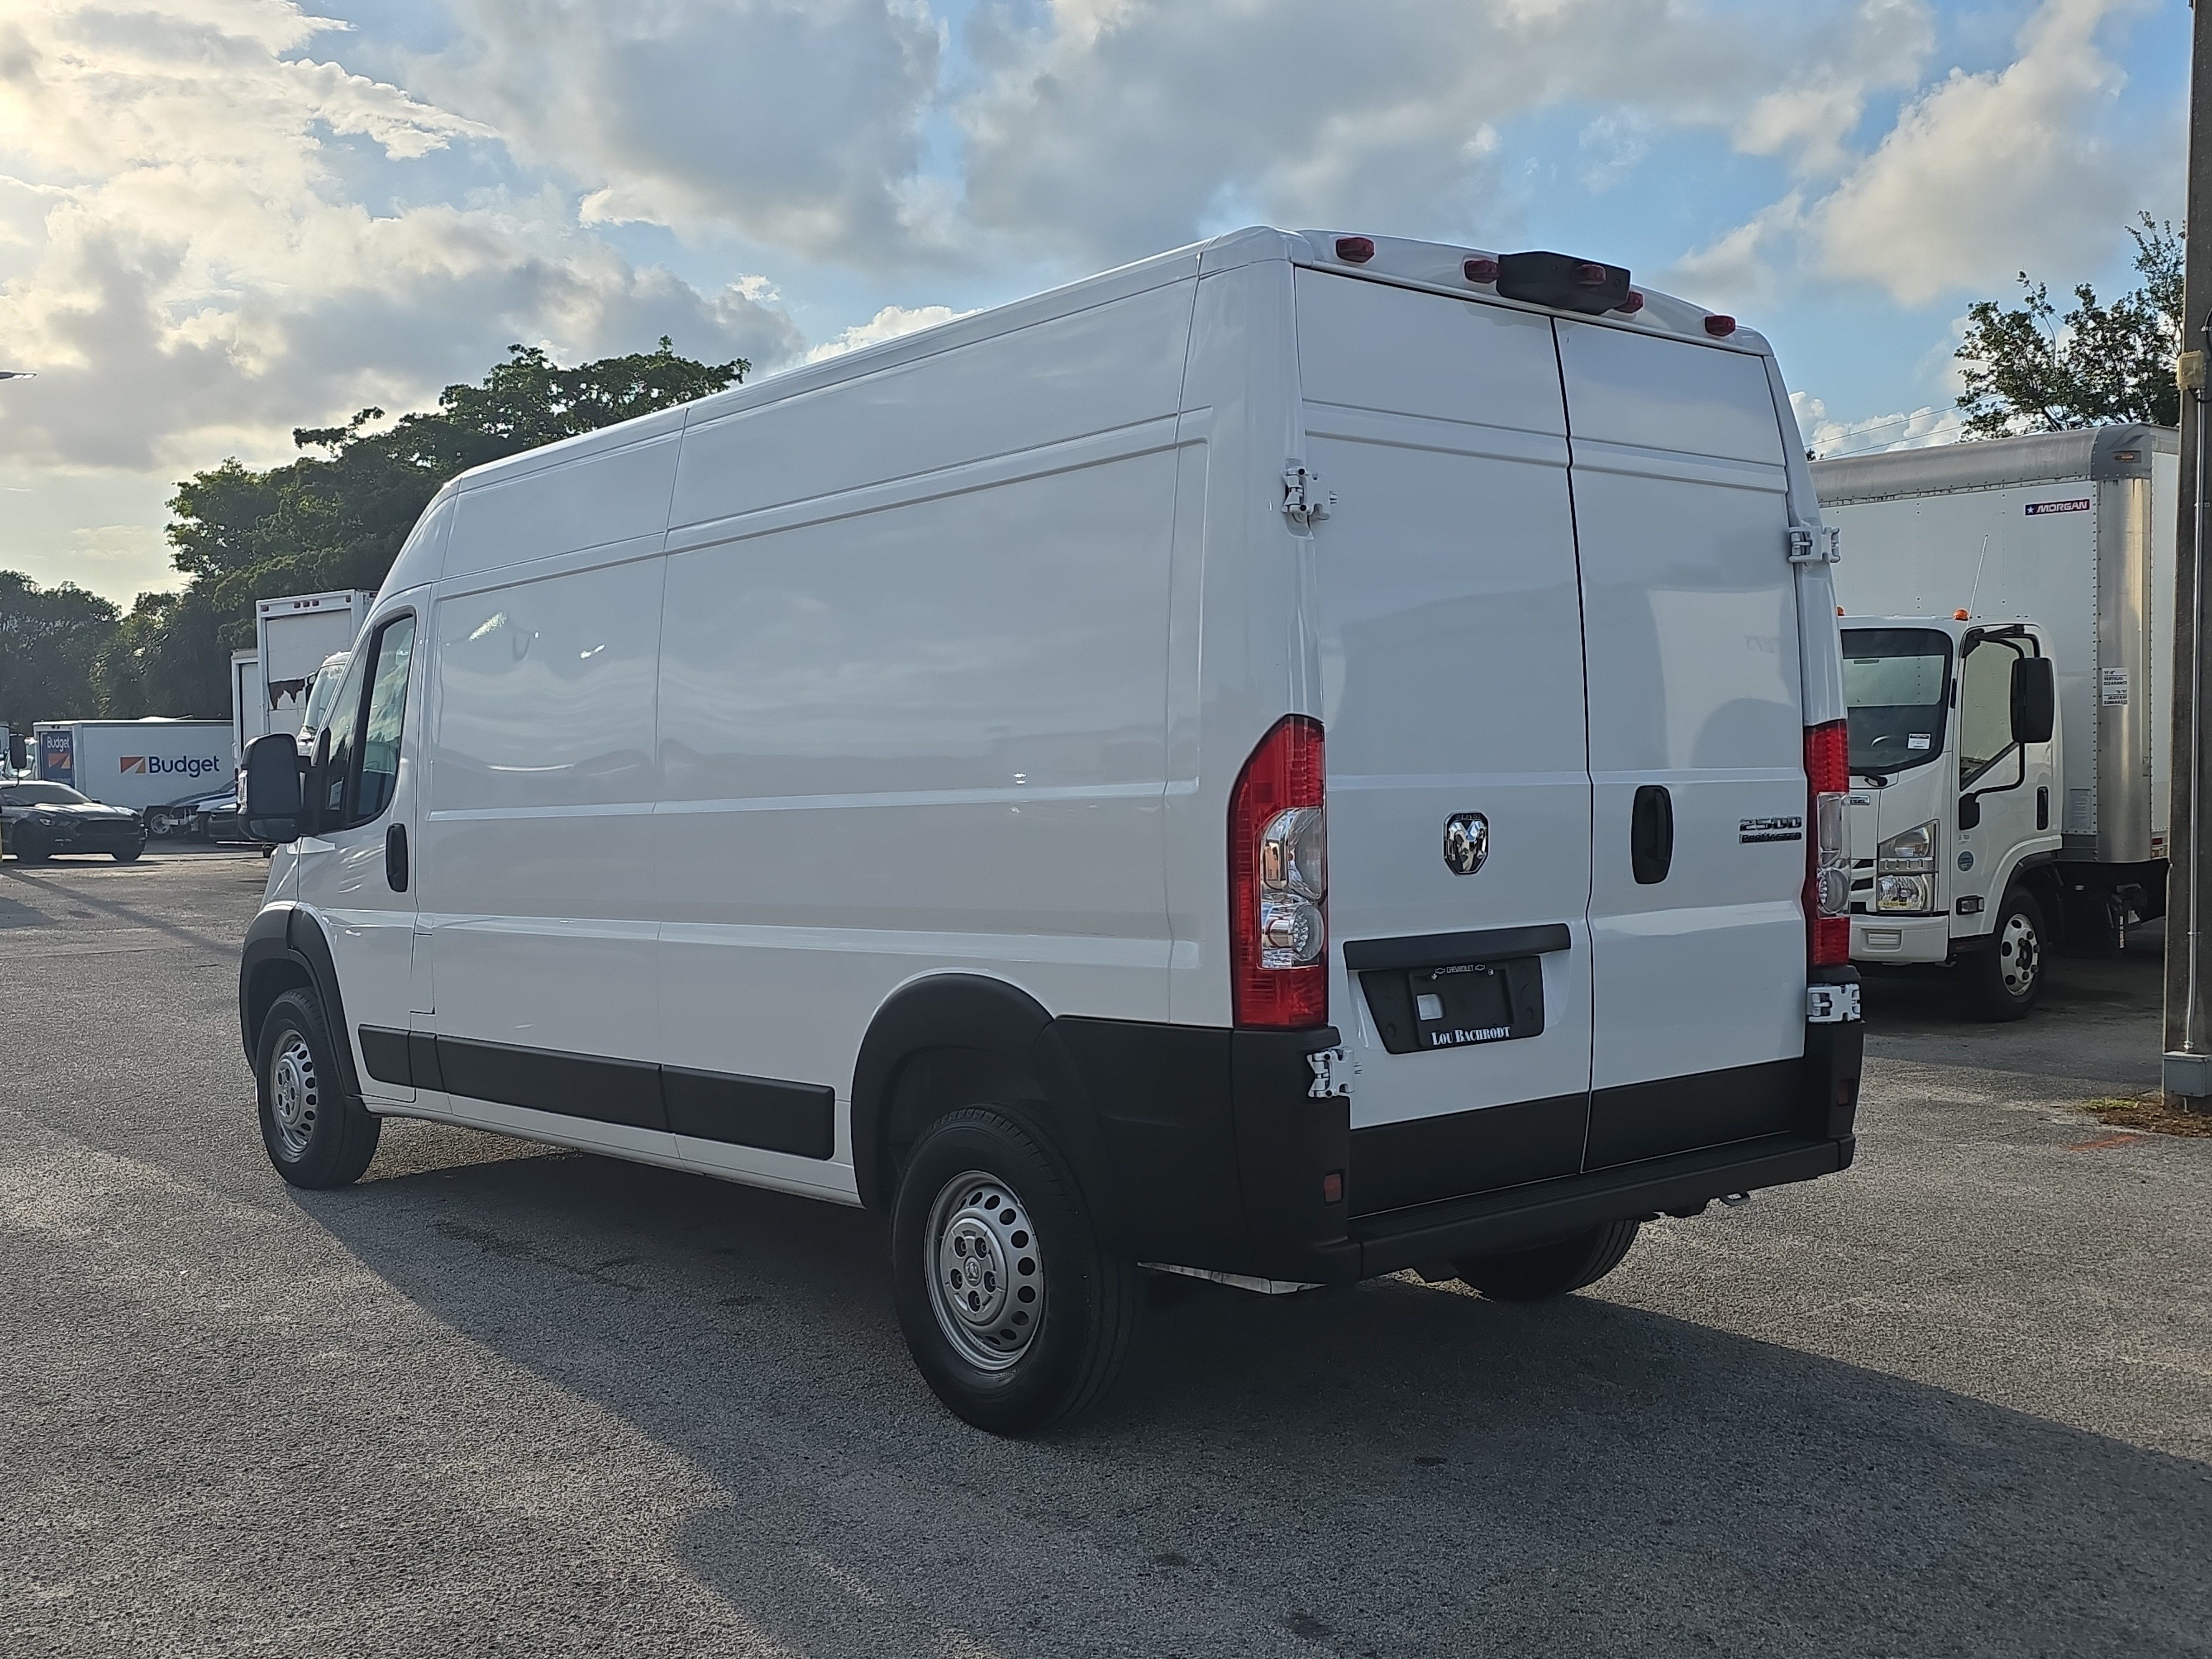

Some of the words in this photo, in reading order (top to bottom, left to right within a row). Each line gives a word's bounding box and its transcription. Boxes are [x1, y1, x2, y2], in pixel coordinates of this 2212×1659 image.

[2036, 501, 2088, 513] MORGAN
[47, 736, 70, 753] Budget
[149, 755, 220, 778] Budget
[1739, 816, 1802, 831] 2500
